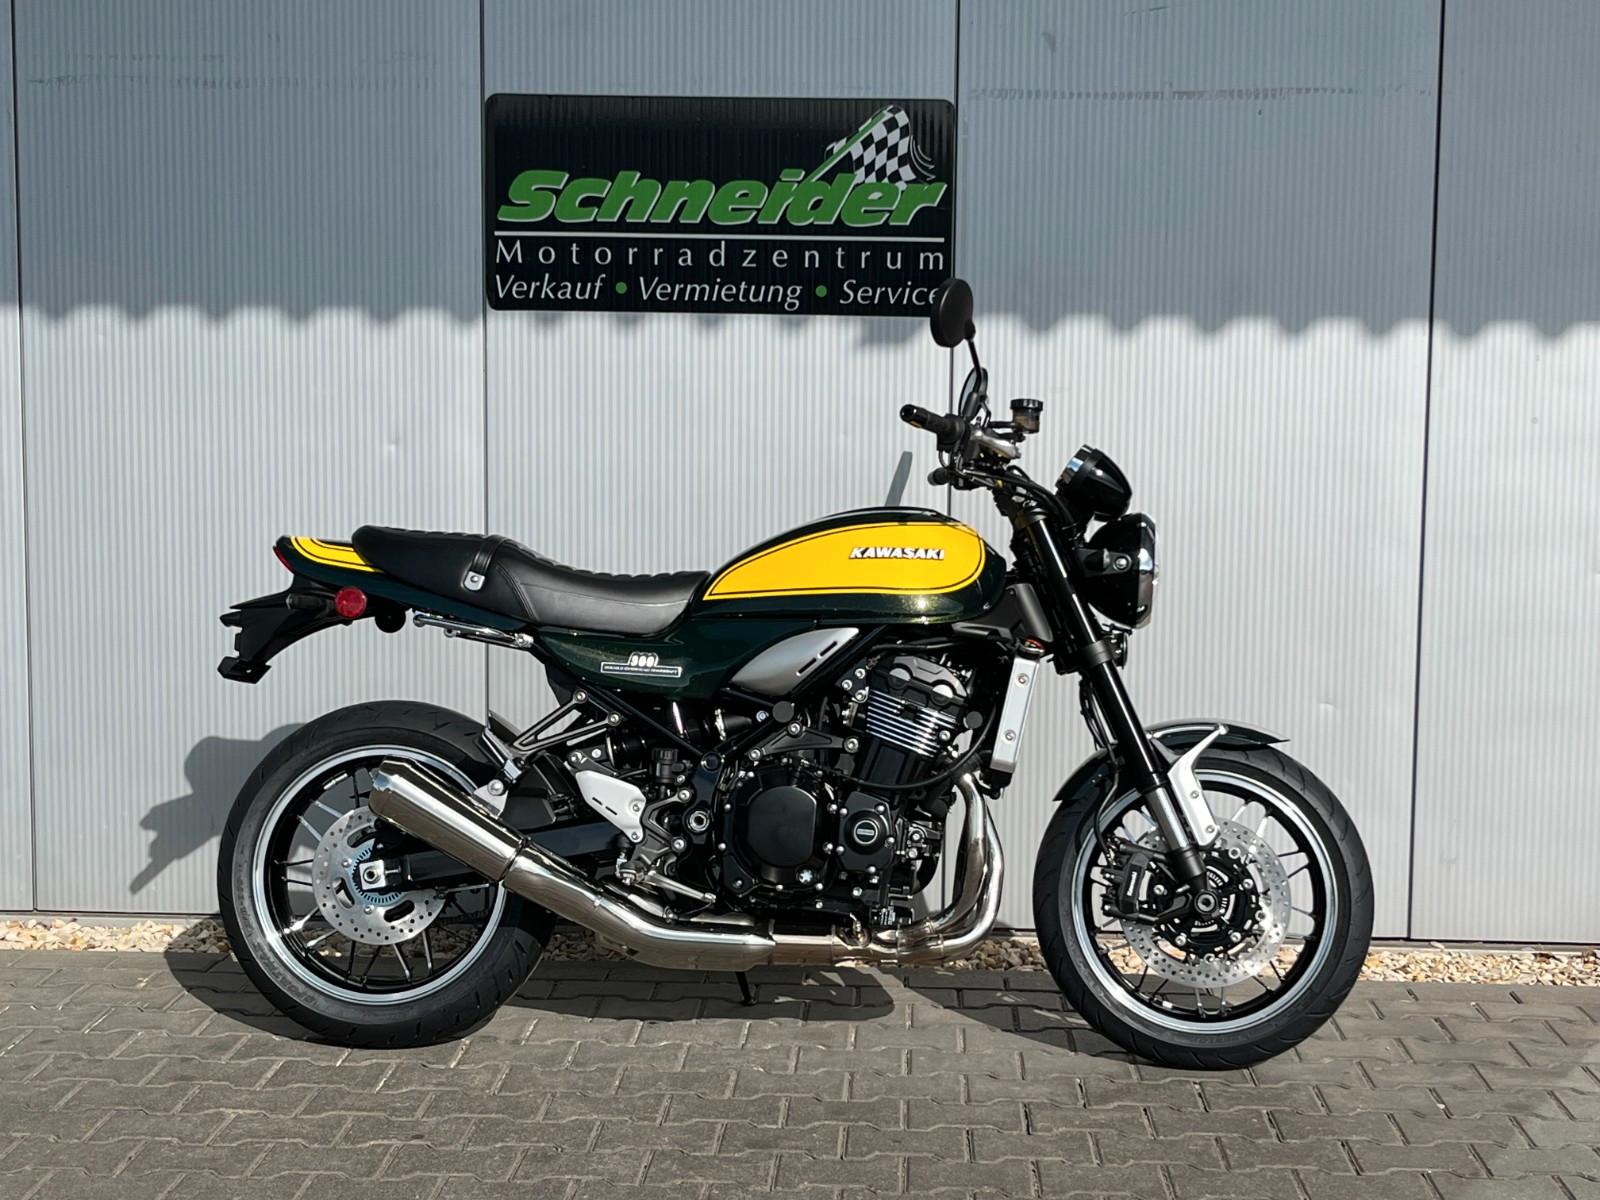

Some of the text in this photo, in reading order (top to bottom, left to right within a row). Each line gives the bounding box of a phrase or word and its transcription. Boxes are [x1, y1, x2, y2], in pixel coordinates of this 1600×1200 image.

[497, 169, 947, 227] Schneider
[495, 239, 945, 270] Motorradzentrum
[495, 273, 606, 300] Verkauf
[639, 276, 803, 311] Vermietung
[848, 546, 945, 561] KAWASAKI
[630, 654, 656, 668] 900
